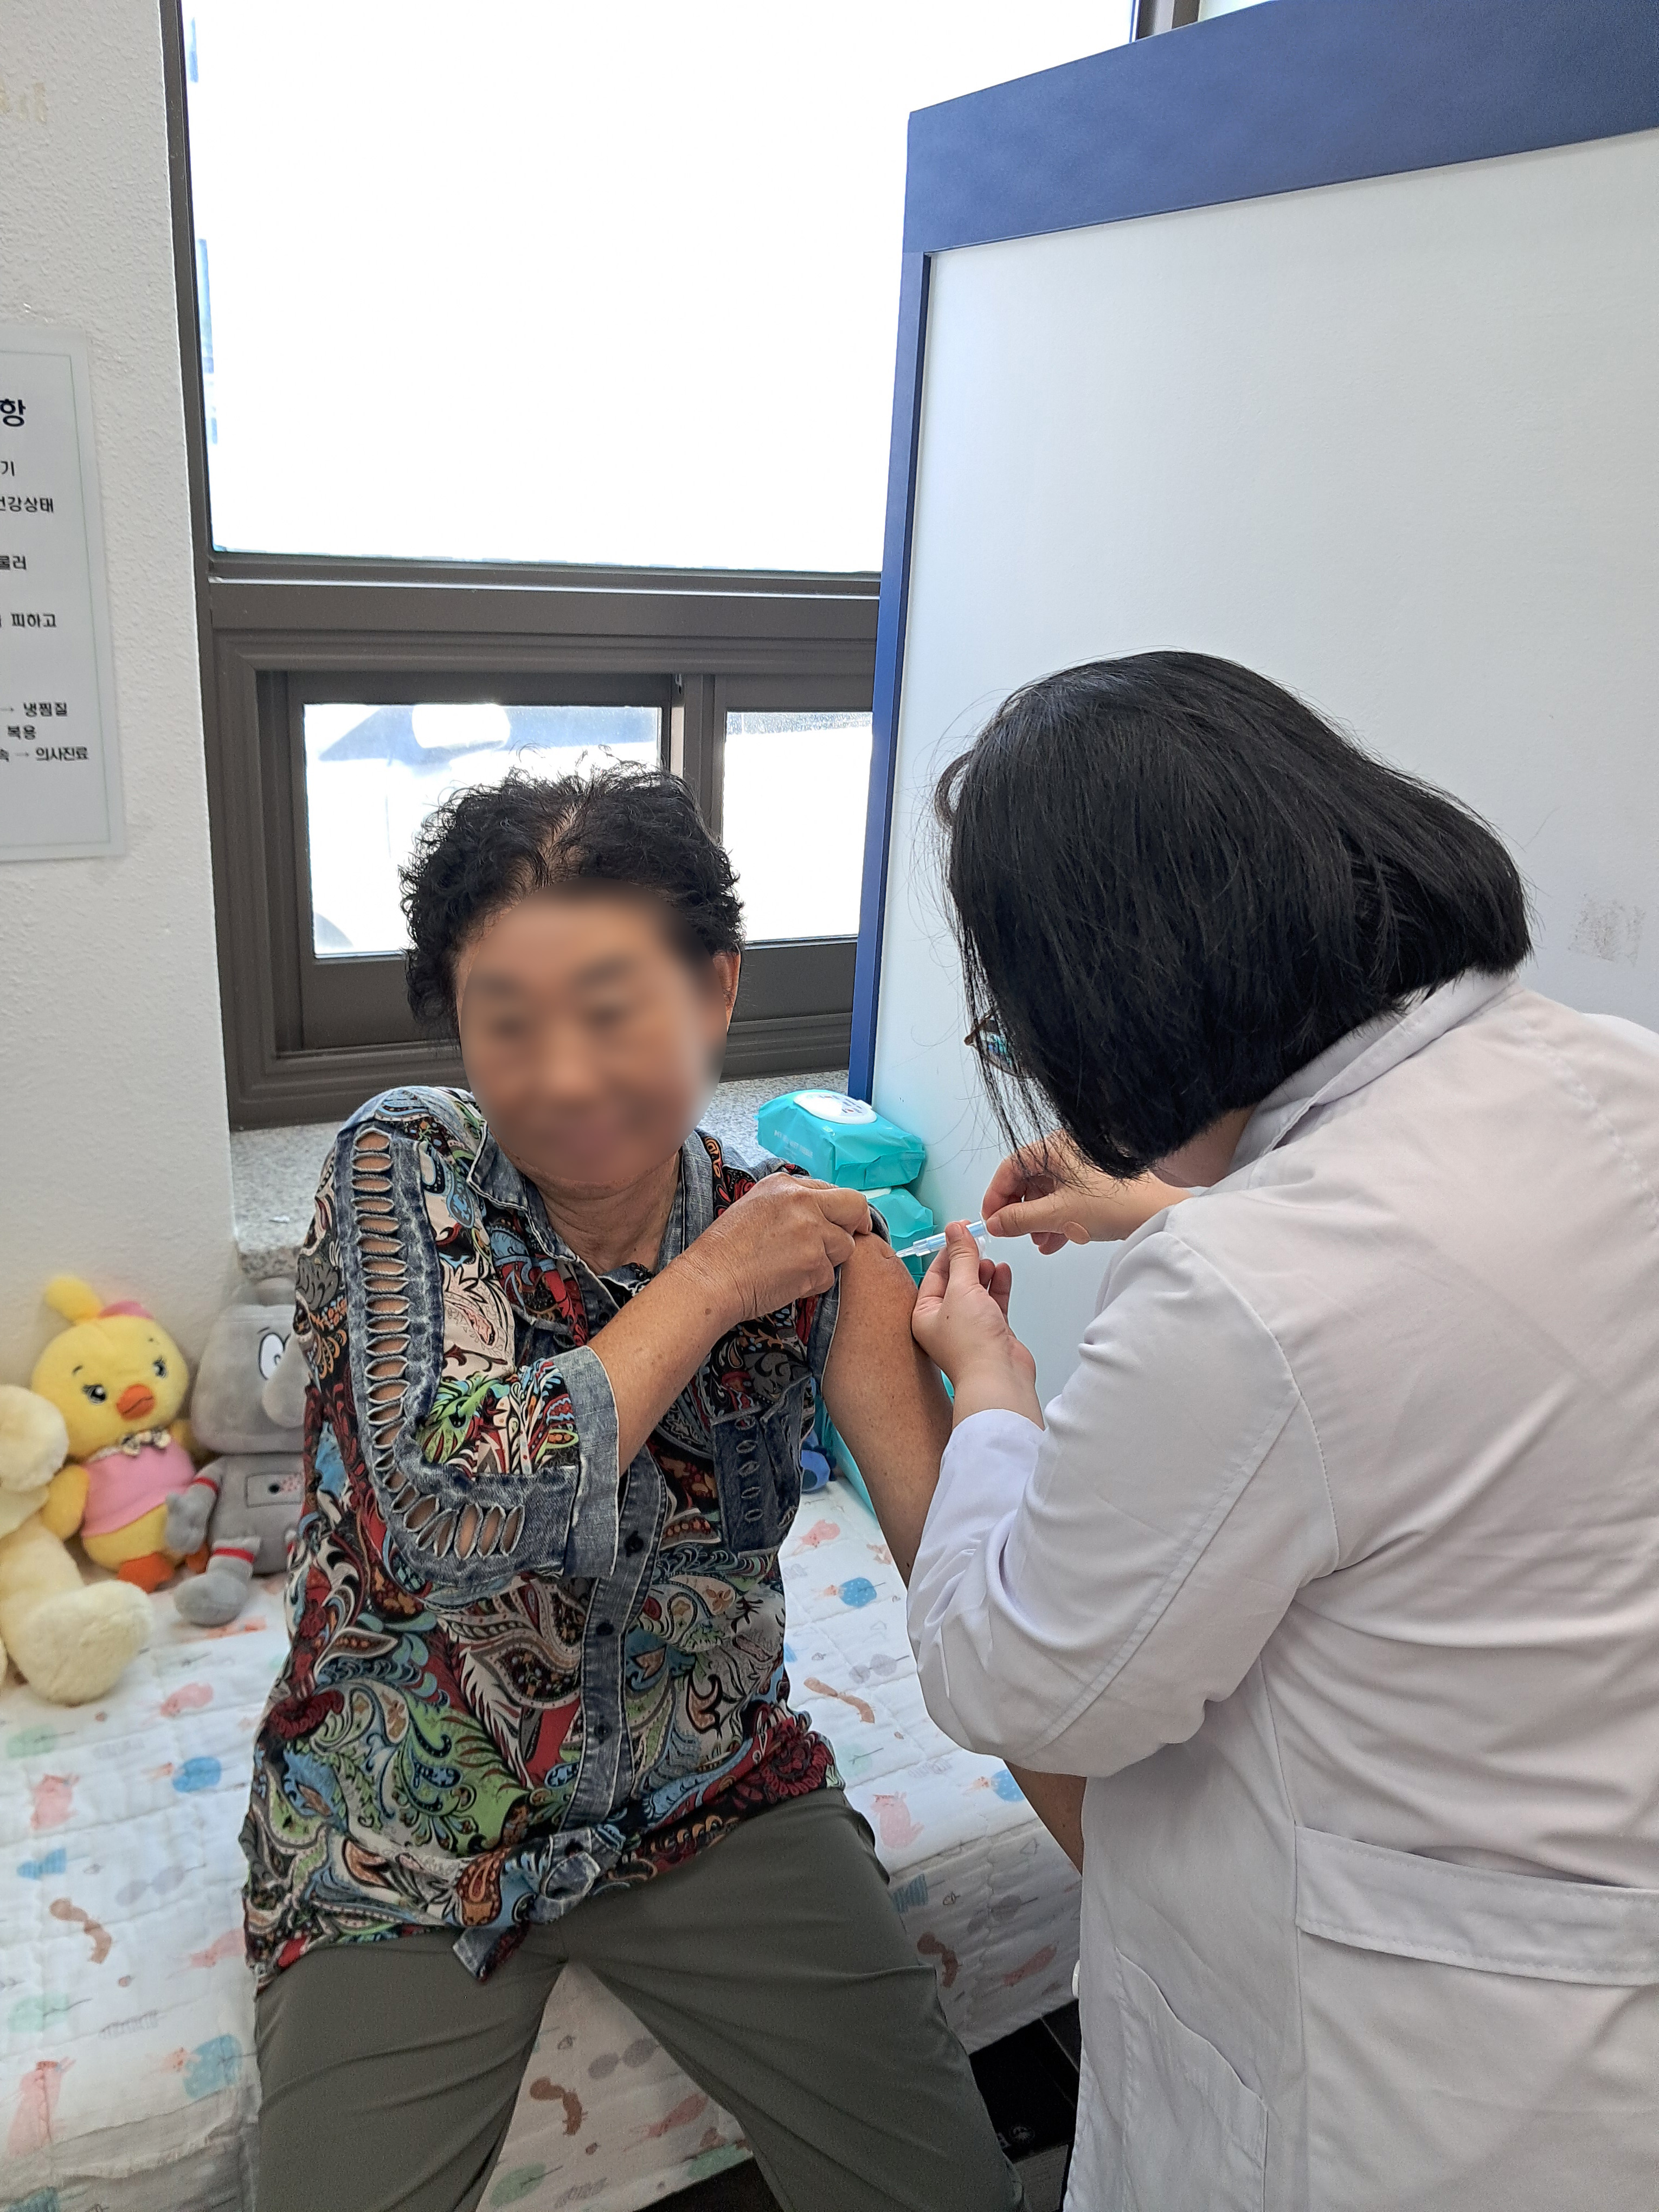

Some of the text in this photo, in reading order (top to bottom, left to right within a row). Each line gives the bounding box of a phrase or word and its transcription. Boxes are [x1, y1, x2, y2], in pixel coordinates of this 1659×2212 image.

[0, 398, 26, 427] 항
[1, 460, 15, 477] 기
[11, 613, 56, 628] 피하고
[36, 747, 88, 761] 의사진료
